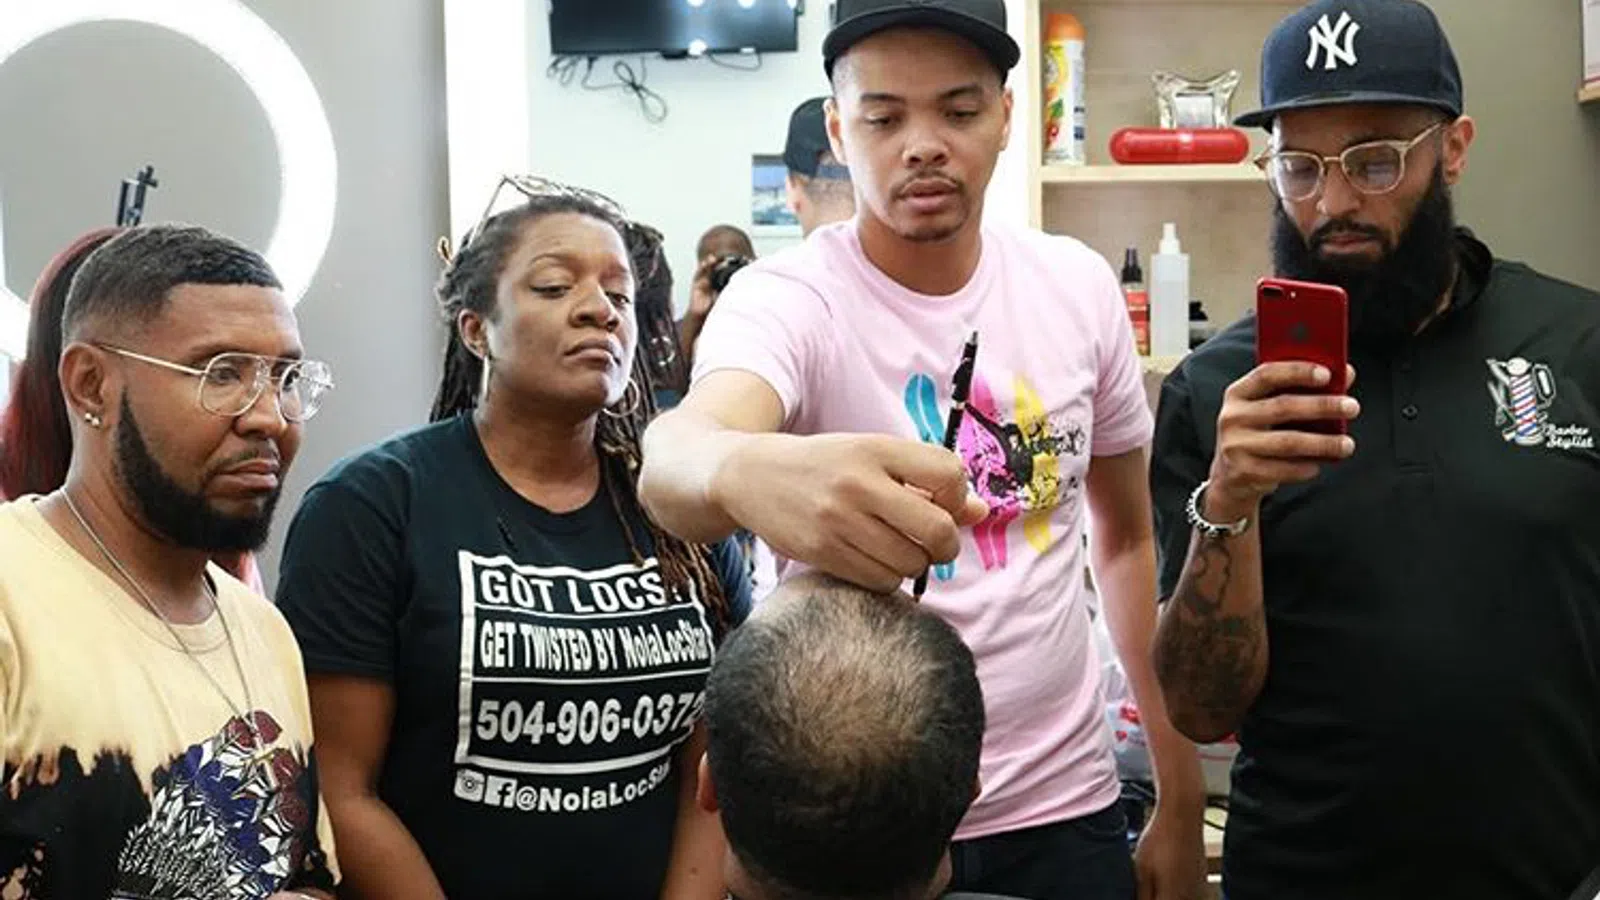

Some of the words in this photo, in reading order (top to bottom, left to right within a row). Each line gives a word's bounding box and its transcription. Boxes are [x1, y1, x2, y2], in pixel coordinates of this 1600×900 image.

[1305, 10, 1360, 70] NY
[480, 570, 554, 612] GOT
[567, 572, 682, 613] LOCS
[479, 620, 517, 668] GET
[519, 623, 592, 671] TWISTED
[591, 628, 619, 670] BY
